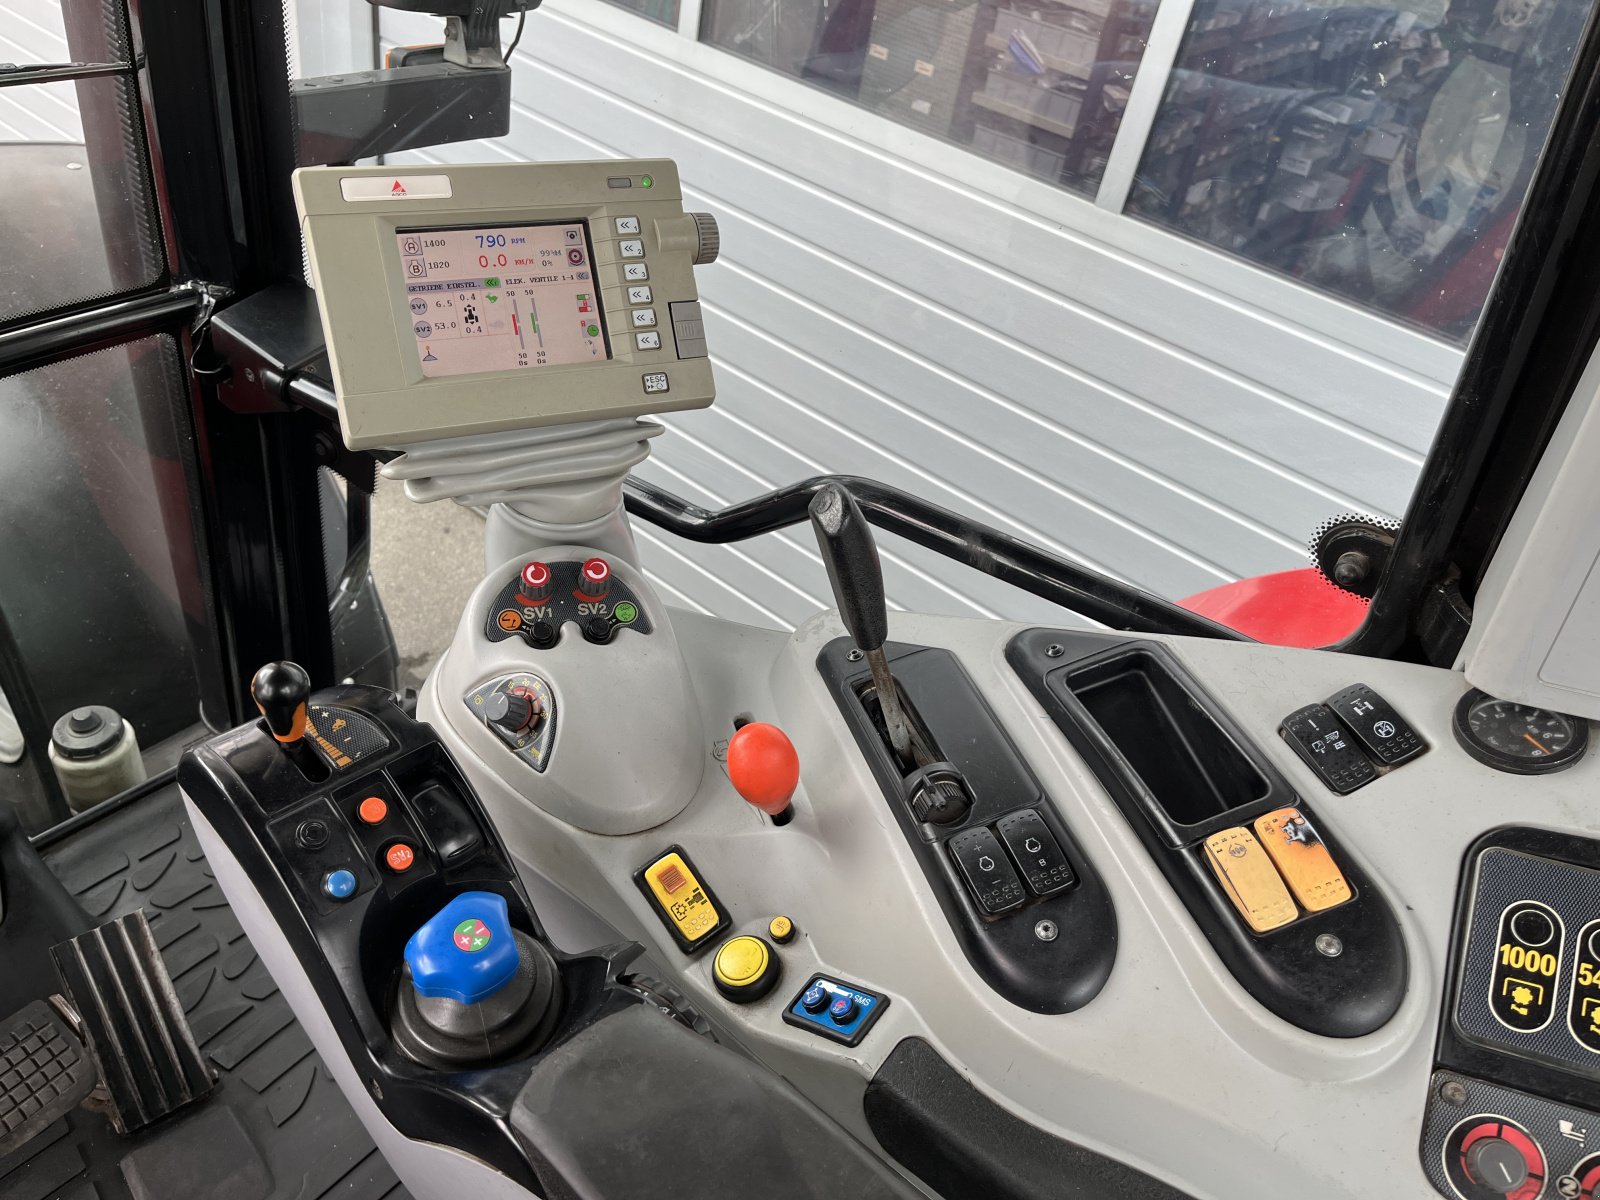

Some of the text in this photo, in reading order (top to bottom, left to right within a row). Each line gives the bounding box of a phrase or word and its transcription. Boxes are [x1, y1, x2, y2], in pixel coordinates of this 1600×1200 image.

[424, 239, 446, 248] 1400
[475, 234, 506, 248] 790
[428, 261, 450, 269] 1820
[479, 254, 507, 268] 0.0
[459, 292, 476, 301] 0.4
[435, 299, 453, 308] 6.5
[434, 321, 457, 330] 53.0
[465, 325, 482, 333] 0.4
[649, 375, 665, 384] ESC
[523, 606, 553, 620] SV1
[577, 602, 608, 616] SV2
[1500, 943, 1556, 977] 1000
[853, 994, 872, 1006] SMS
